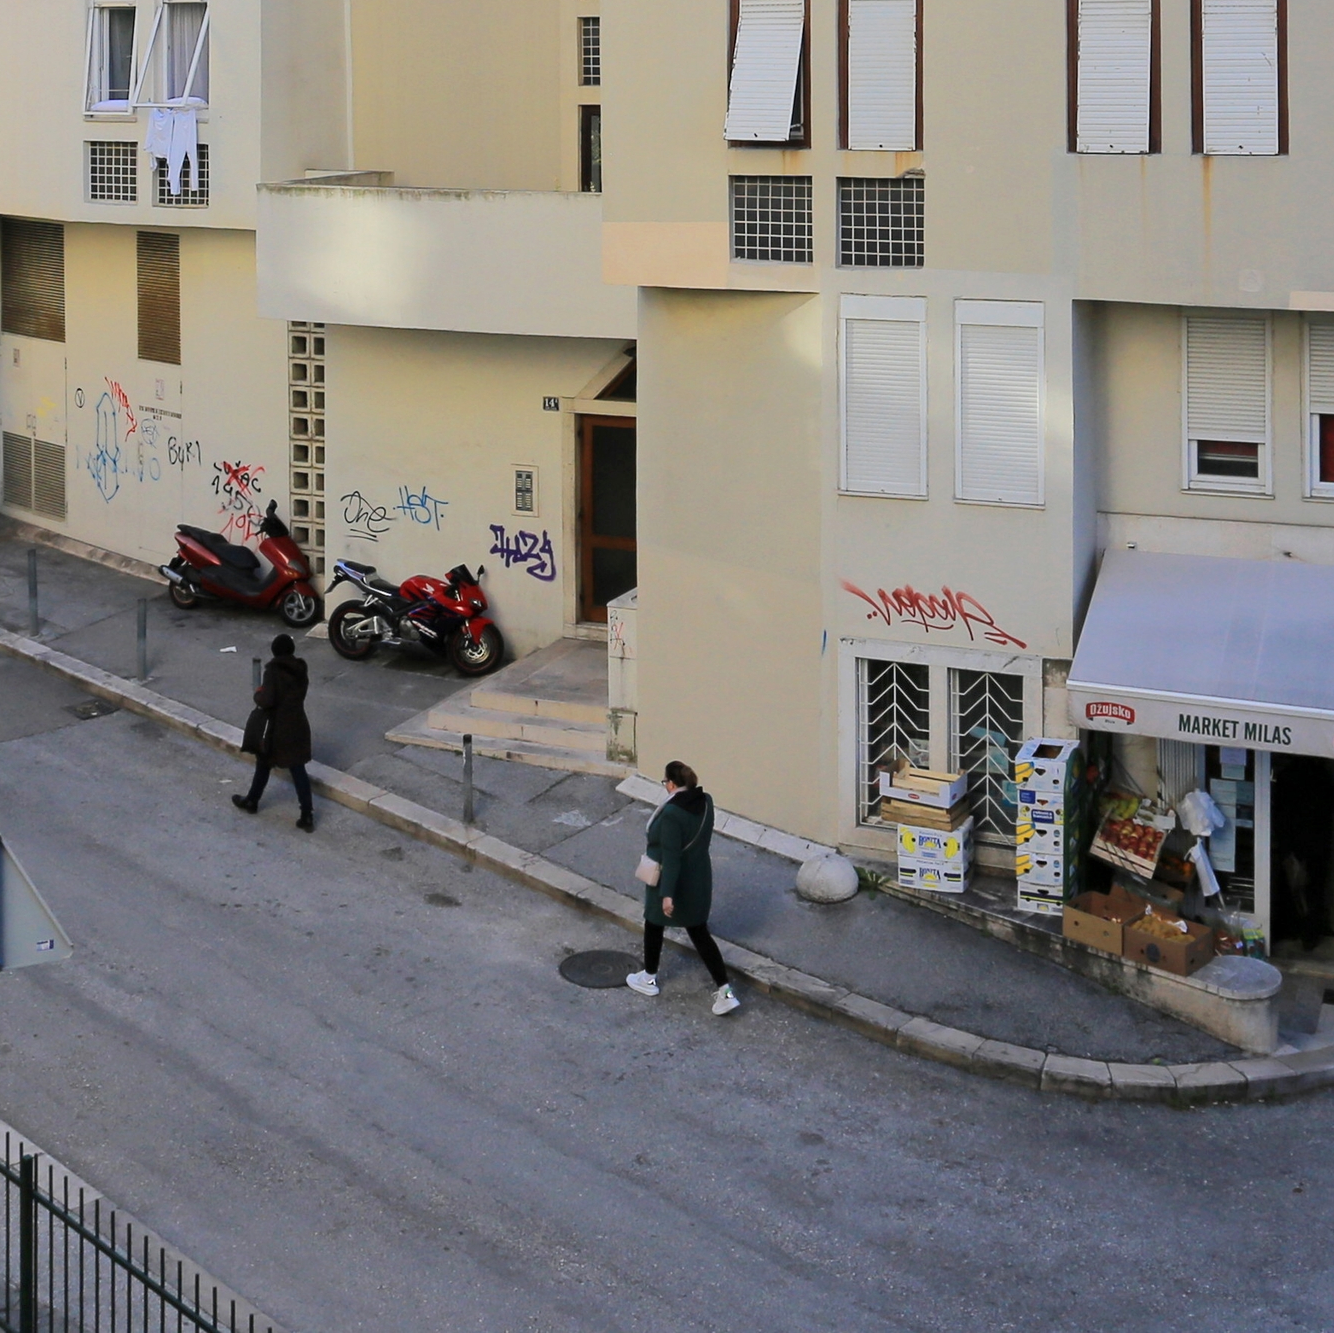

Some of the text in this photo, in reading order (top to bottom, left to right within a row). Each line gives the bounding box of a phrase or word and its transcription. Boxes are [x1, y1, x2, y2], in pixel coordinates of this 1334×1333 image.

[1090, 703, 1131, 720] Ožujsko
[1178, 714, 1292, 746] MARKET MILAS
